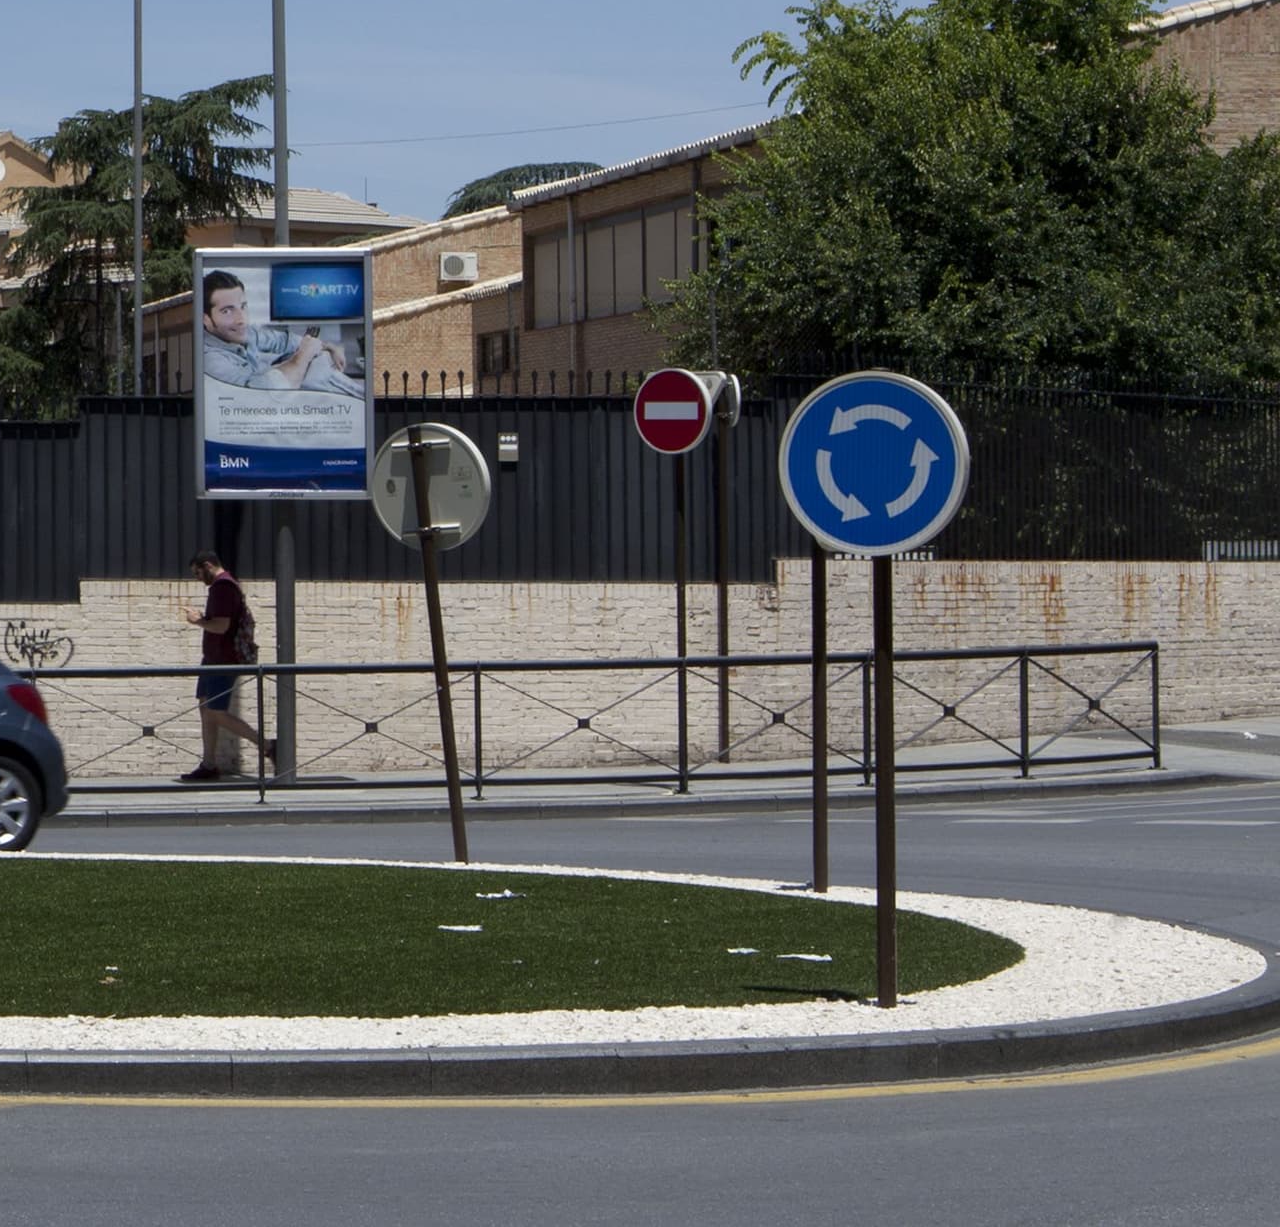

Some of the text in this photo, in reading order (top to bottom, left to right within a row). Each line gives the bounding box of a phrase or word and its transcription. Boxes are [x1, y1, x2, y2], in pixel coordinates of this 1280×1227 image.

[344, 284, 359, 296] TV
[219, 404, 352, 416] Te mereces una Smart TV
[220, 456, 249, 468] BMN
